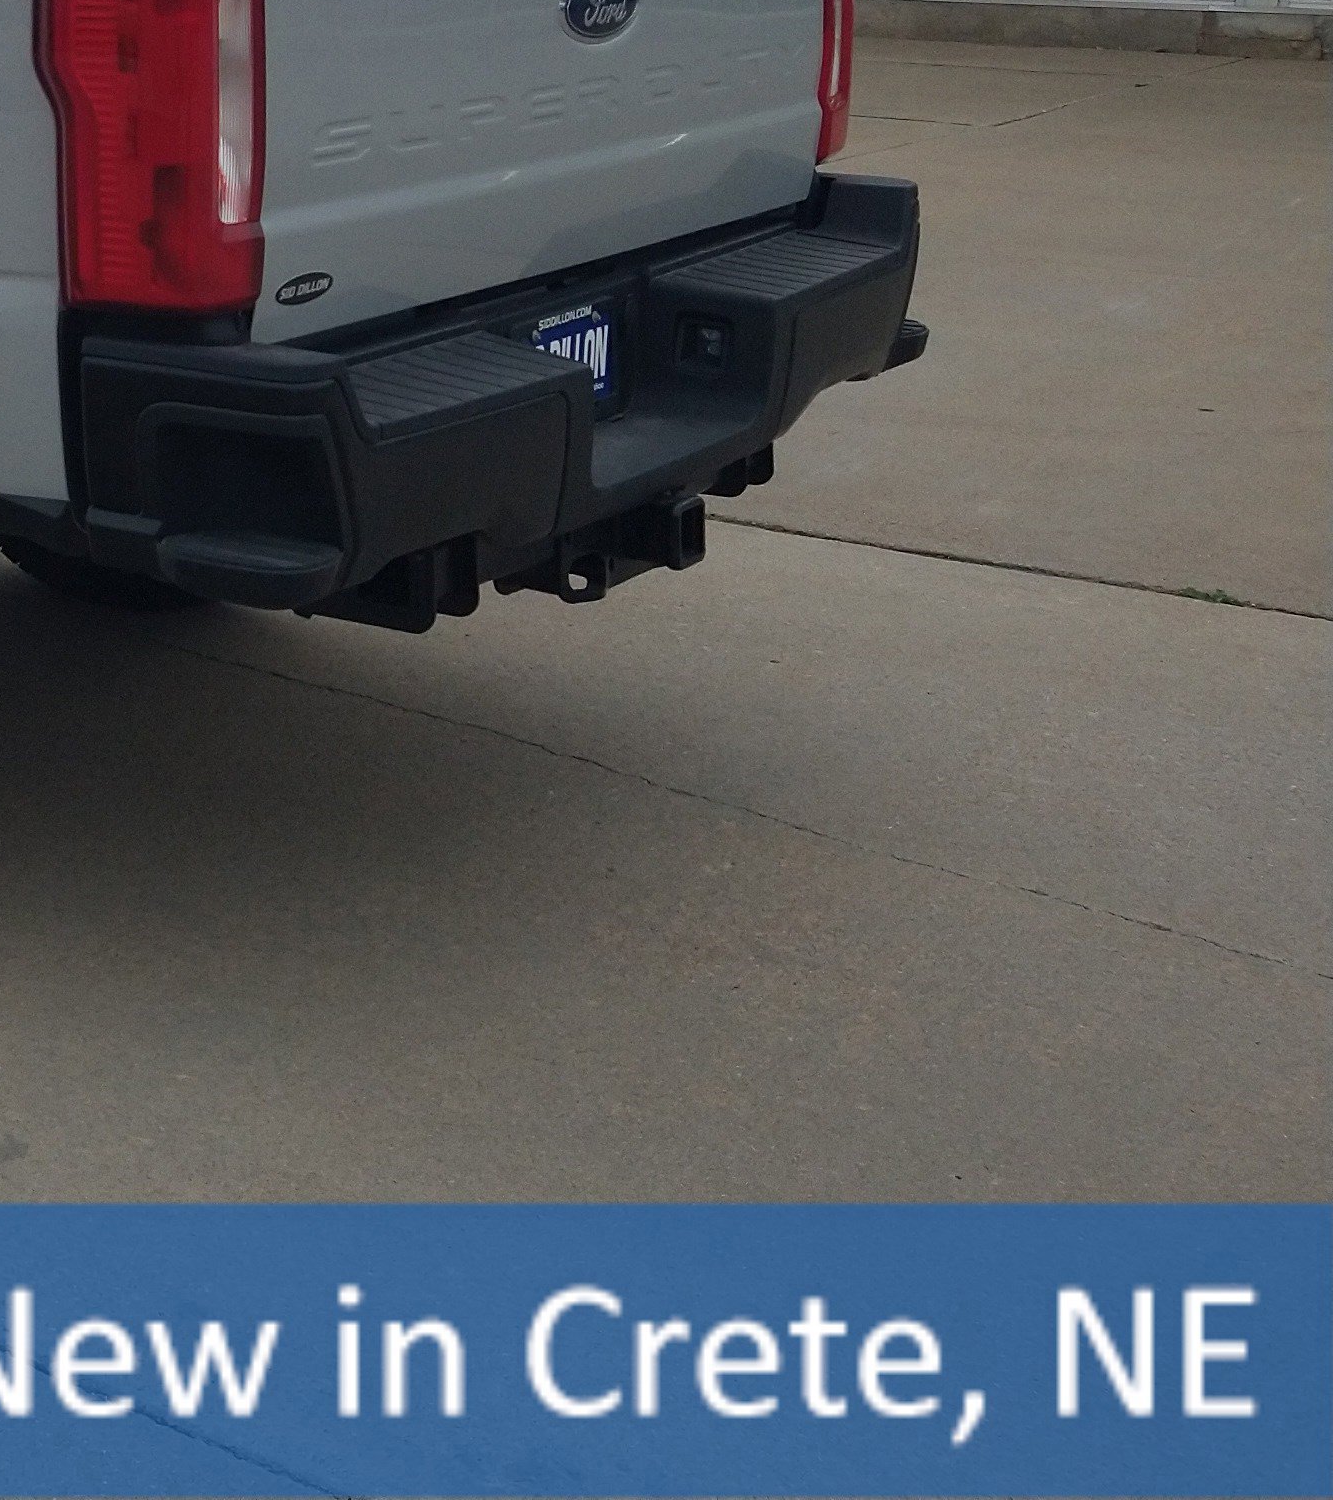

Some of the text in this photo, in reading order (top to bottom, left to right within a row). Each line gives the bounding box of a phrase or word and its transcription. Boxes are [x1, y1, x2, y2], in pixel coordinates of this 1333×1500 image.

[312, 74, 621, 168] SUPER
[278, 277, 331, 301] SID DILLON
